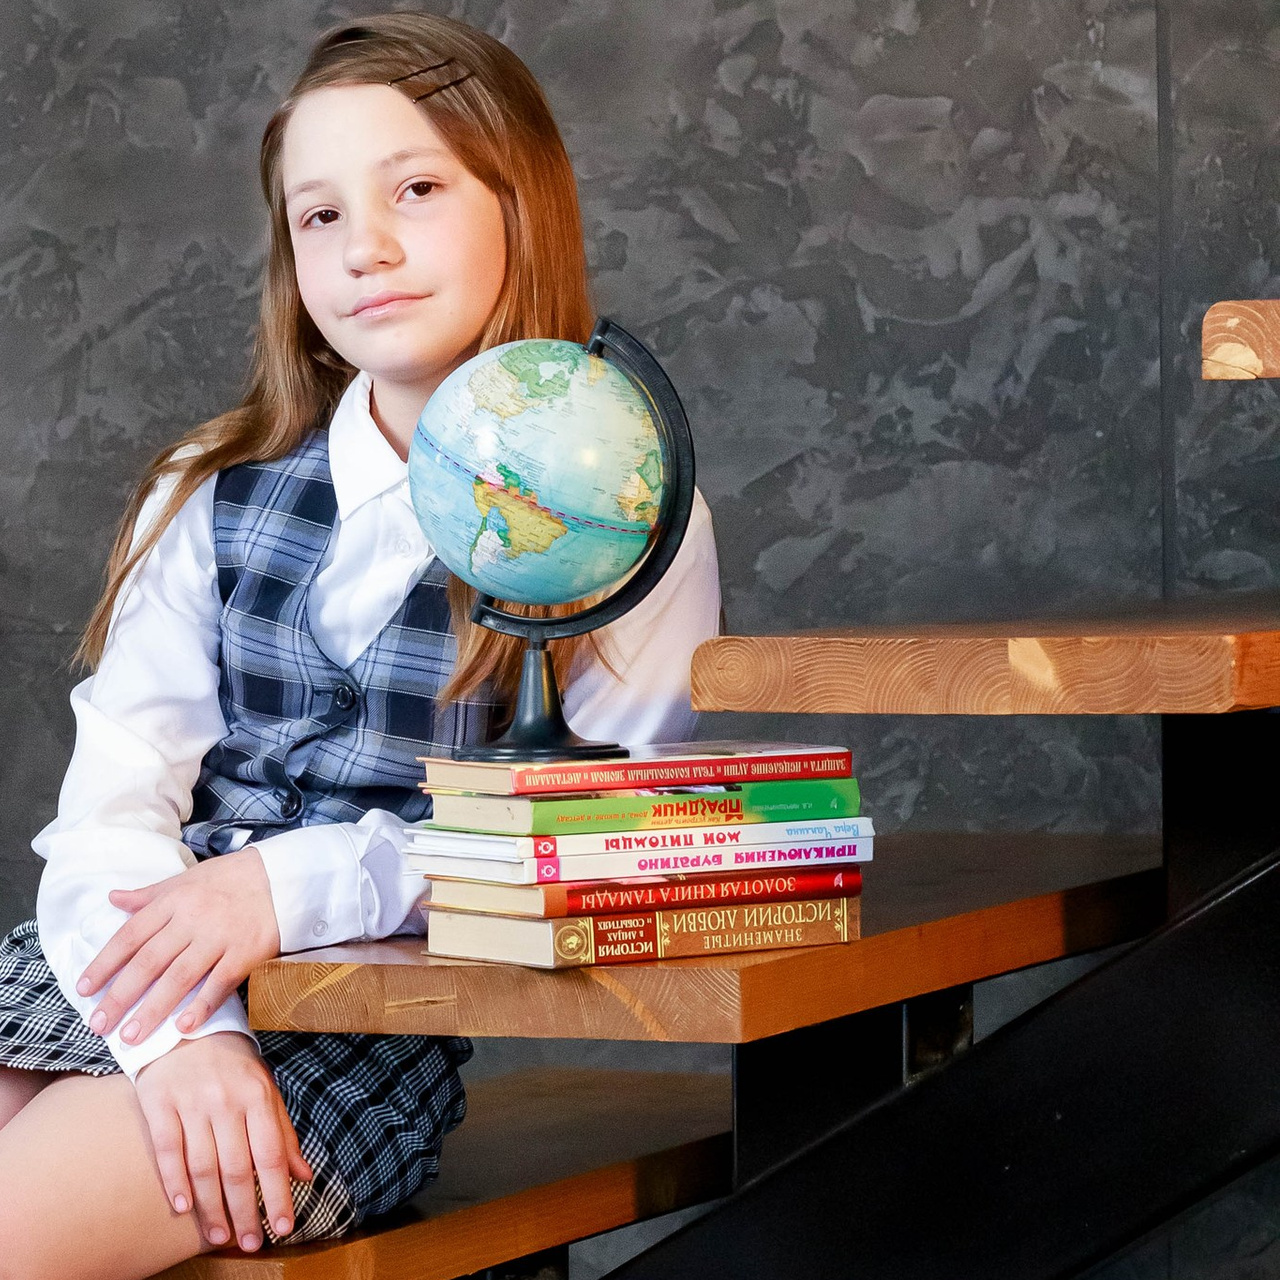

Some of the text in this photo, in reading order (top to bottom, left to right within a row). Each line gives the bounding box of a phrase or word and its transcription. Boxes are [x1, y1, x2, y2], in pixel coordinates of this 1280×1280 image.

[692, 767, 715, 778] ТЕЛА
[724, 763, 749, 776] ДУШИ
[751, 760, 802, 775] ИСЦЕЛЕНИЕ
[810, 758, 846, 772] ЗАЩИТА
[525, 771, 582, 786] МЕТАЛЛАМИ
[591, 770, 625, 784] ЗВОНОМ
[627, 767, 691, 782] КОЛОКОЛЬНЫМ
[651, 798, 743, 818] ПРАЗДНИК
[785, 821, 860, 838] Вера Чаплина
[605, 833, 694, 851] ПИТОМЦЫ
[637, 845, 857, 871] ПРИКЛЮЧЕНИЯ БУРАТИНО
[581, 876, 797, 910] ЗОЛОТАЯ КНИГА ТАМАДЫ
[598, 918, 645, 931] СОБЫТИЯХ
[673, 902, 831, 934] ИСТОРИИ ЛЮБВИ
[608, 930, 637, 942] ЛИЦАХ
[704, 928, 803, 950] ЗНАМЕНИТЫЕ
[598, 942, 654, 957] ИСТОРИЯ
